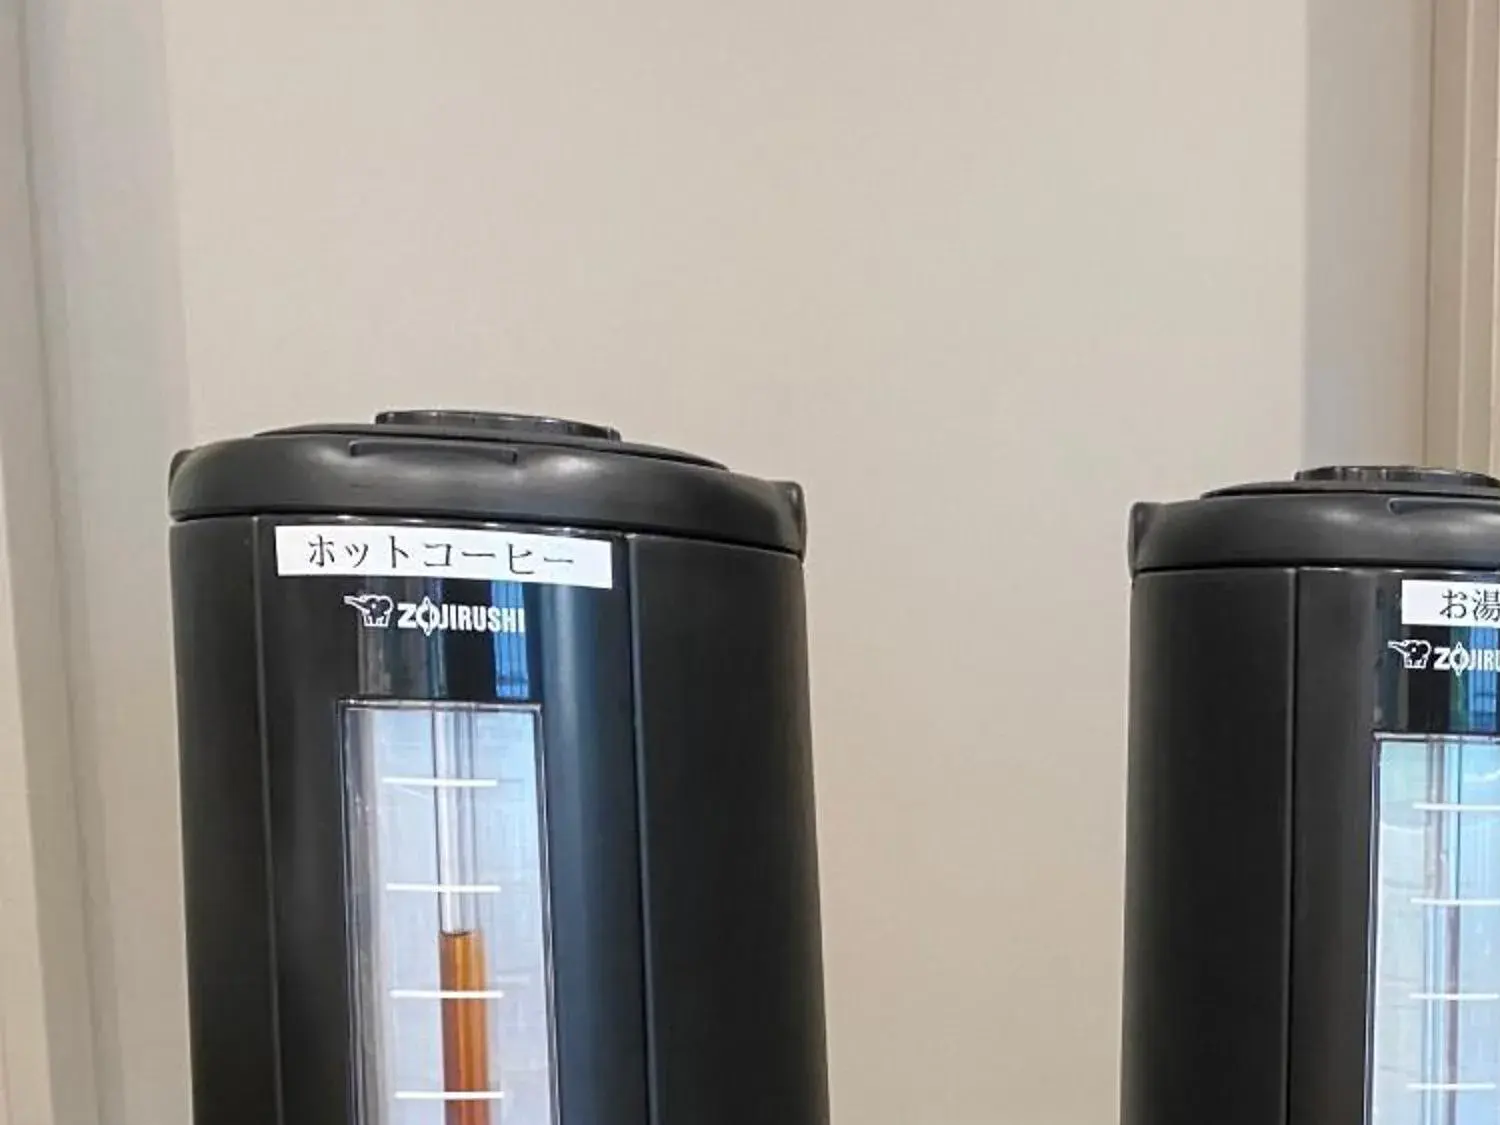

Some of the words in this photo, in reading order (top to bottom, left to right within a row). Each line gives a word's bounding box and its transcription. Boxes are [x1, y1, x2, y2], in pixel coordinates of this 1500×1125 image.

[307, 533, 576, 575] ホットコーヒー
[397, 597, 525, 637] ZOJIRUSHI
[1440, 589, 1500, 622] お湯
